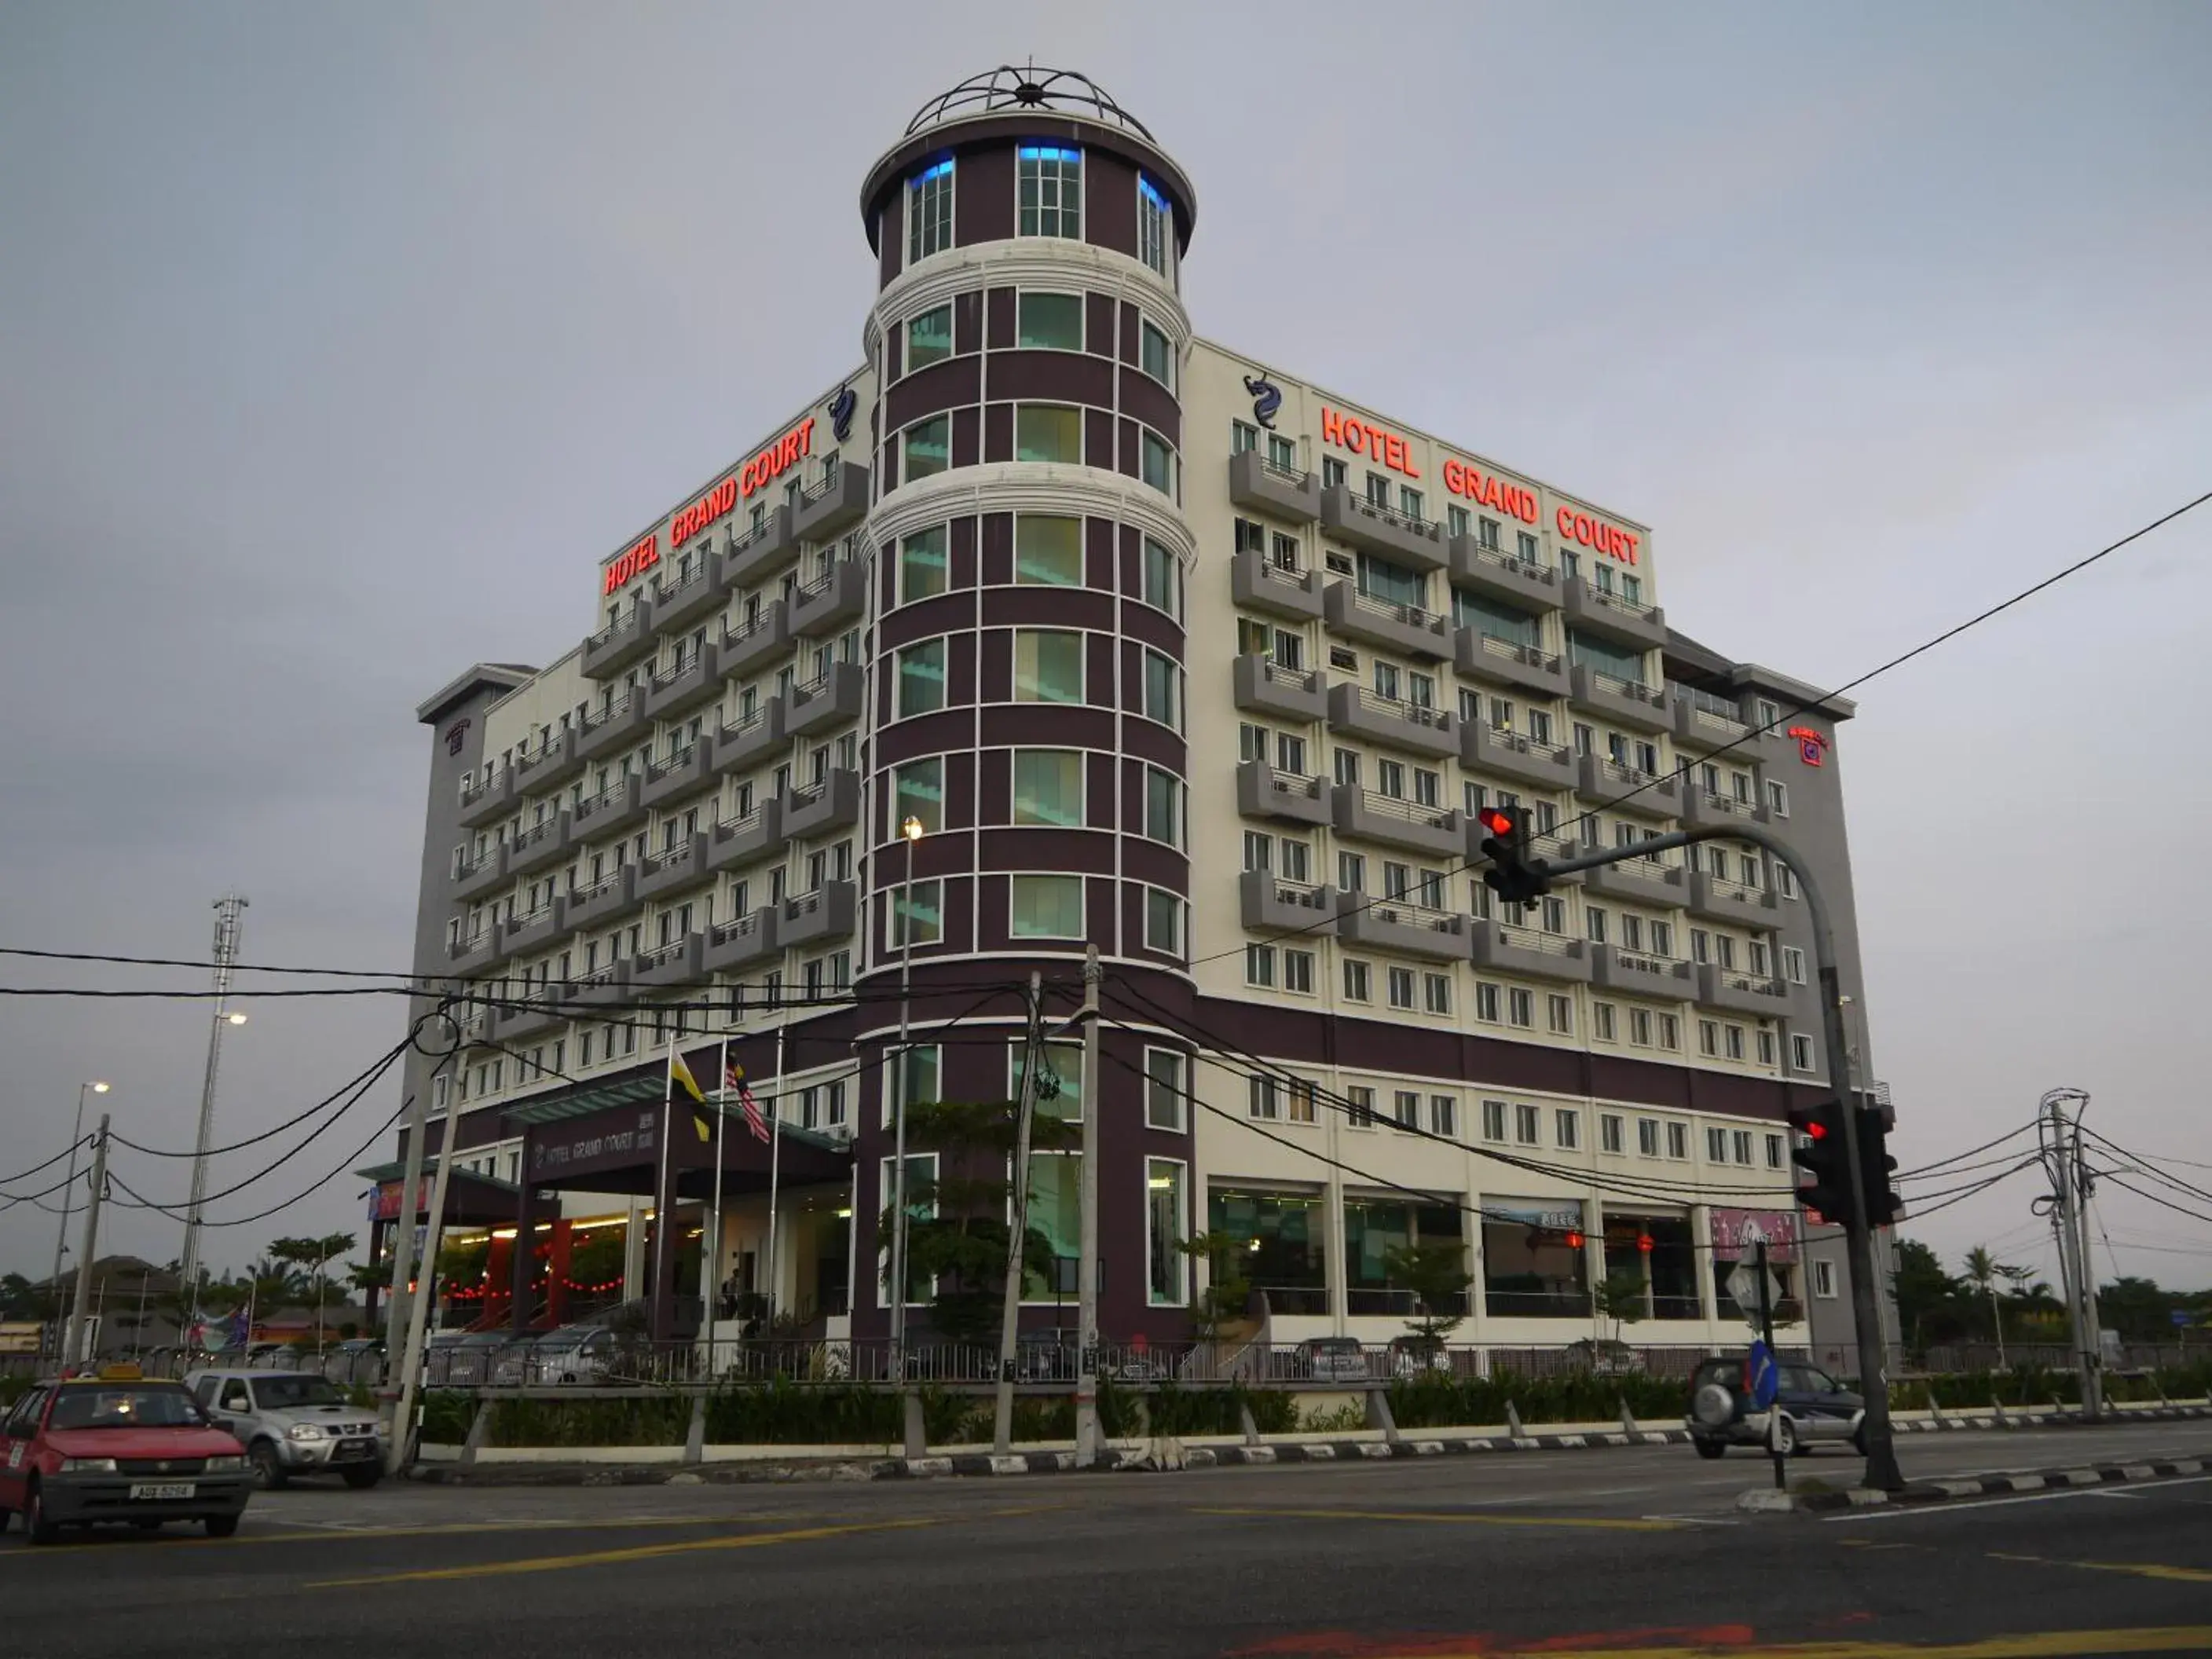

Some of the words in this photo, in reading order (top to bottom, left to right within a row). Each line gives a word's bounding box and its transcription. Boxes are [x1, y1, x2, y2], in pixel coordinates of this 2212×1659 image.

[602, 535, 661, 595] HOTEL
[670, 476, 737, 548] GRAND
[740, 417, 815, 497] COURT
[1322, 406, 1421, 478] HOTEL
[1444, 460, 1539, 525] GRAND
[1556, 505, 1639, 566] COURT
[573, 1137, 602, 1159] GRAND
[603, 1131, 634, 1152] COURT
